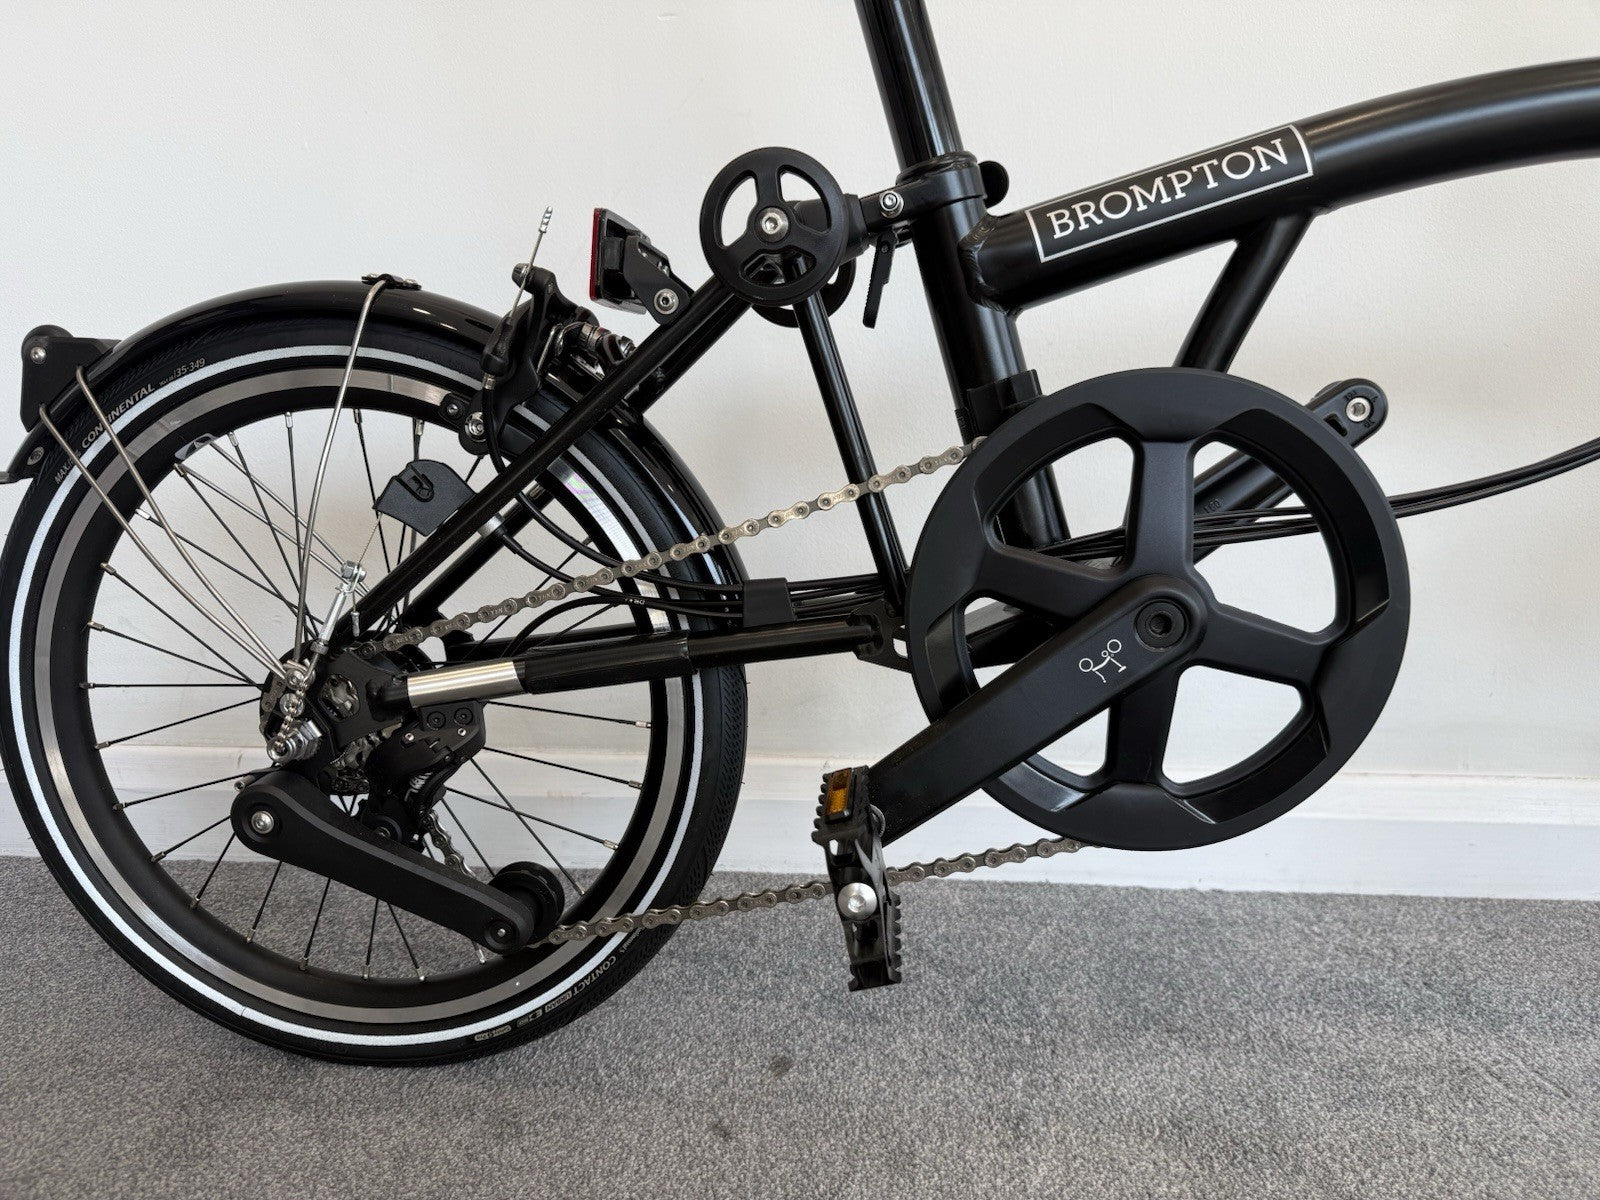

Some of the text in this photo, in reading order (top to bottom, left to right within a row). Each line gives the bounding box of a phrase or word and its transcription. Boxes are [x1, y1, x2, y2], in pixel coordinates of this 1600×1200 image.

[1047, 138, 1288, 239] BROMPTON
[82, 383, 155, 449] CONINENTAL
[573, 956, 617, 995] CONTACT
